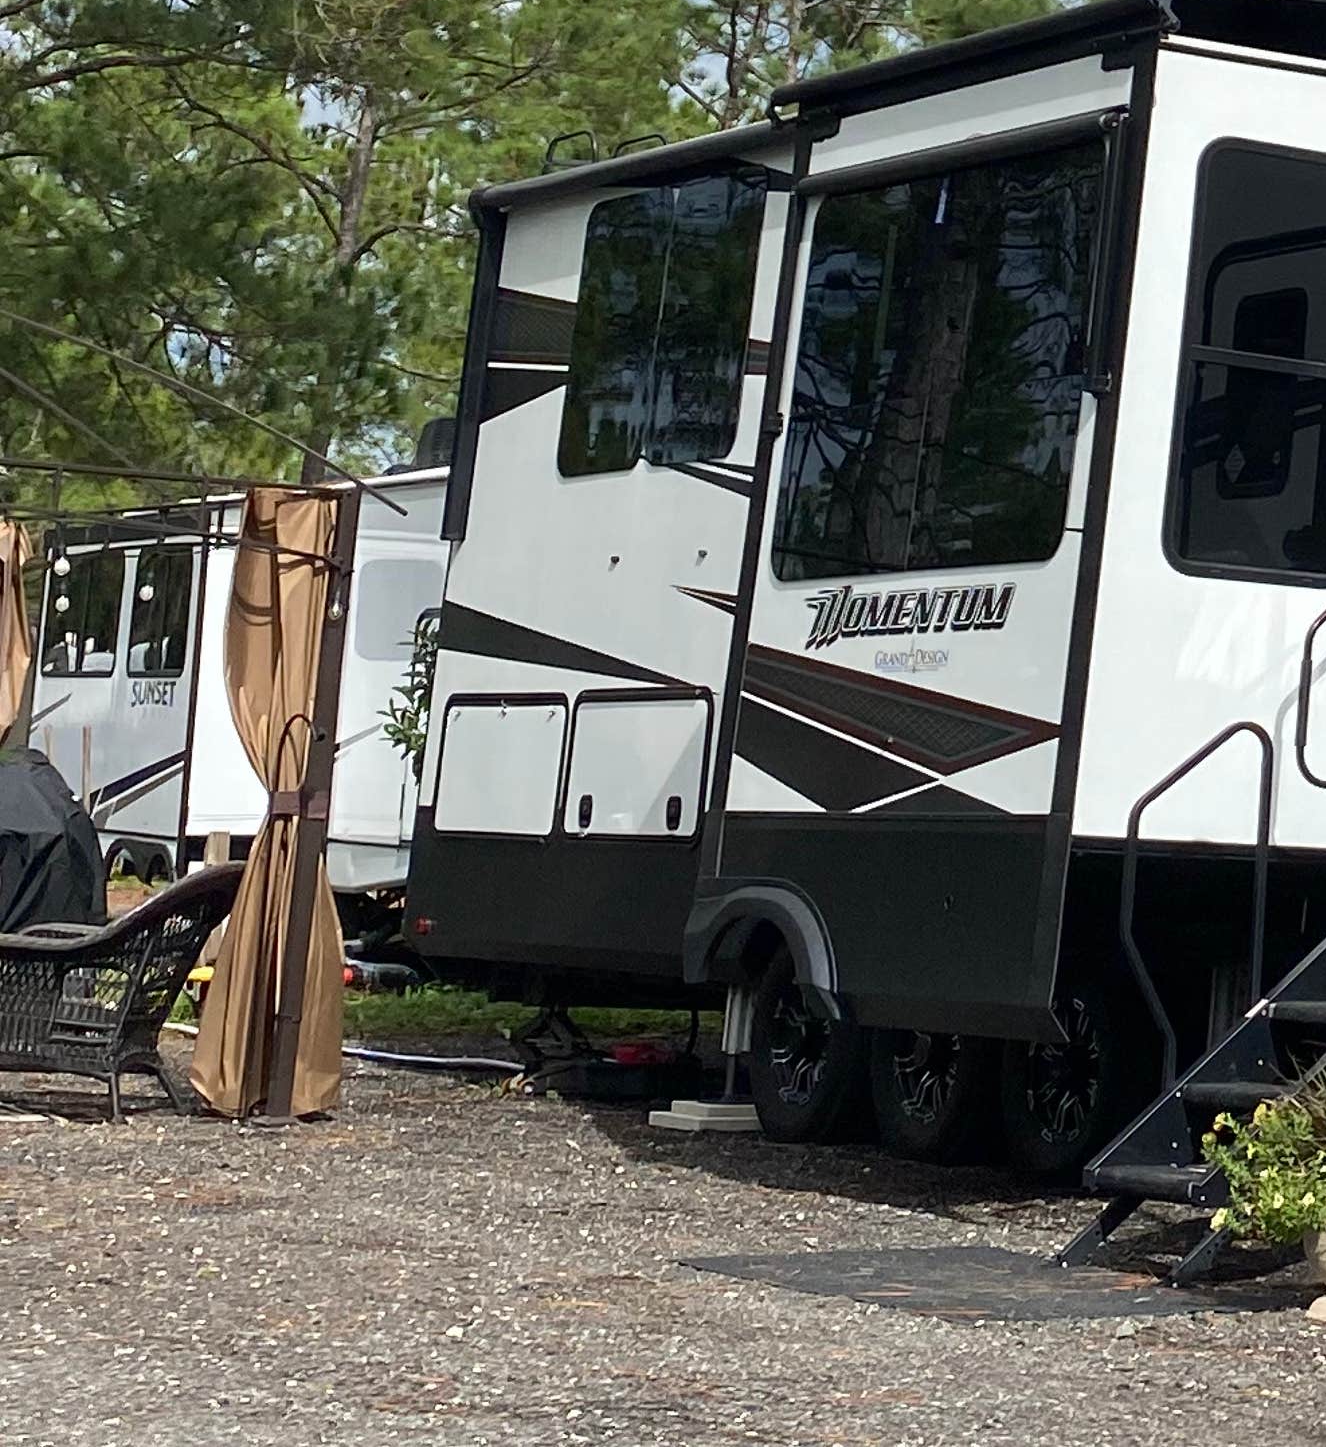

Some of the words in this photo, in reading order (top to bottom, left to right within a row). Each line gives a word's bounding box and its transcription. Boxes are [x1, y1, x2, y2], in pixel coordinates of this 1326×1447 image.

[804, 582, 1017, 651] MOMENTUM
[874, 650, 908, 667] GRAND
[915, 648, 950, 665] DESIGN
[131, 680, 177, 708] SUNSET
